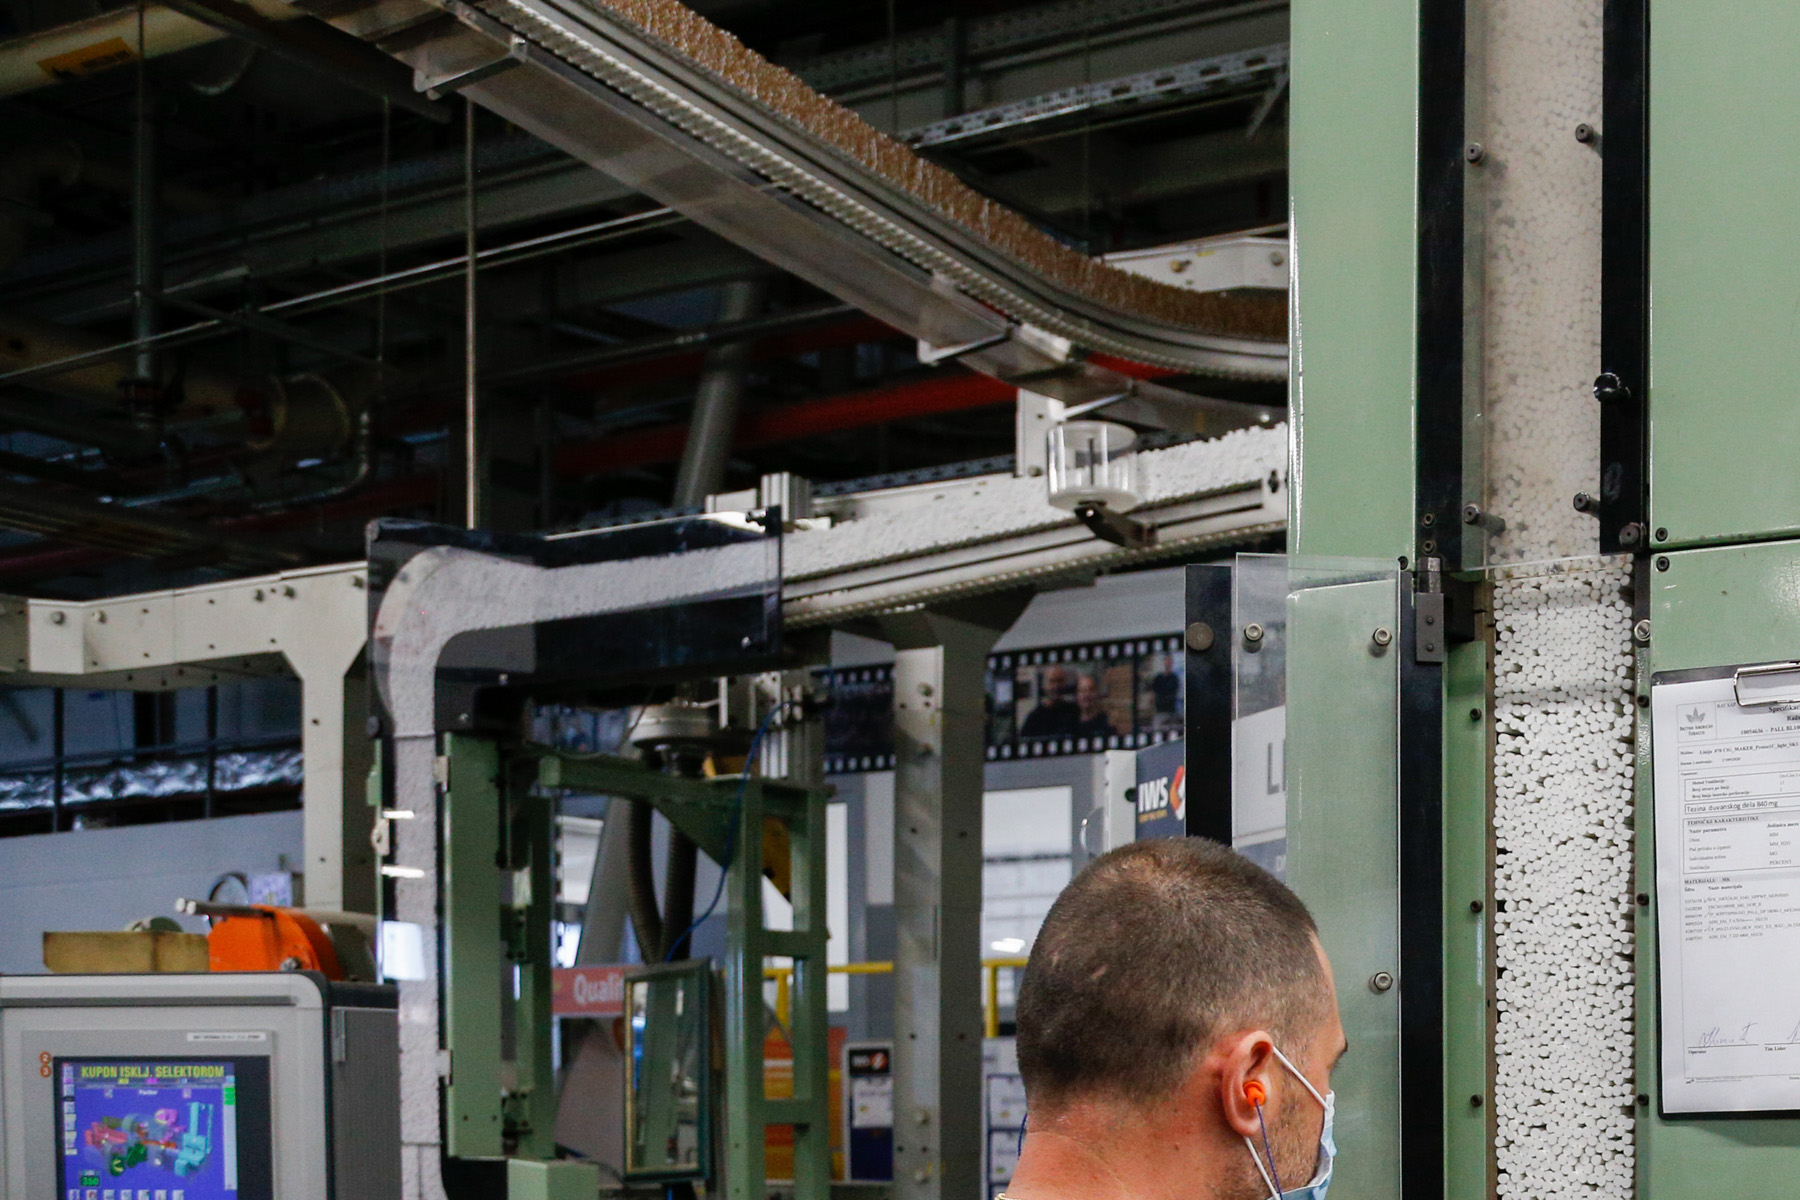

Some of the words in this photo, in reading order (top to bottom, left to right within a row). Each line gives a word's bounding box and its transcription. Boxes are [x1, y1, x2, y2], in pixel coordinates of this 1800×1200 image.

[1138, 776, 1168, 813] IWS
[1709, 803, 1741, 811] duvanskog
[574, 972, 625, 1006] Qualit
[80, 1066, 117, 1078] KUPON
[155, 1065, 225, 1078] SELEKTOROM
